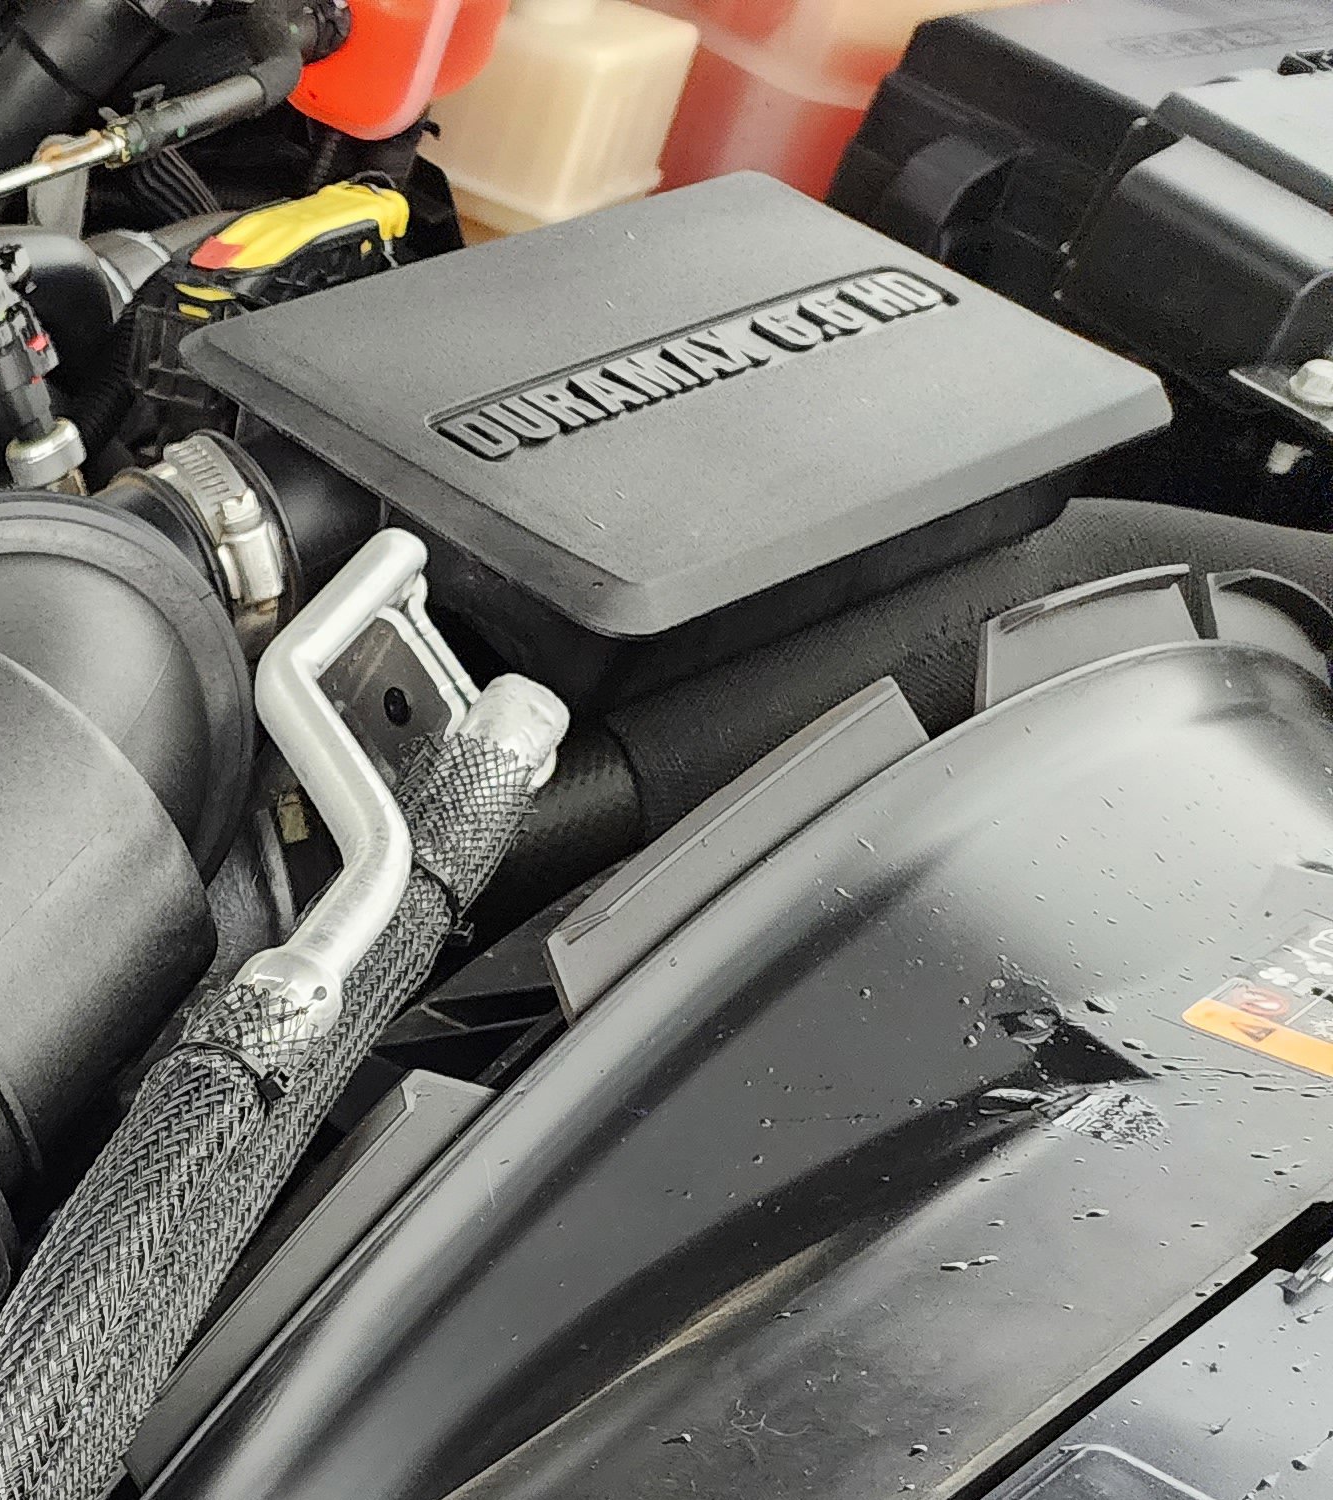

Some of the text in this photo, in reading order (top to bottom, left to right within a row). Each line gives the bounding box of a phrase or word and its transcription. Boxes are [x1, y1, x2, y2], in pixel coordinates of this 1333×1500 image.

[441, 270, 948, 460] DURAMAX 6.6 HD
